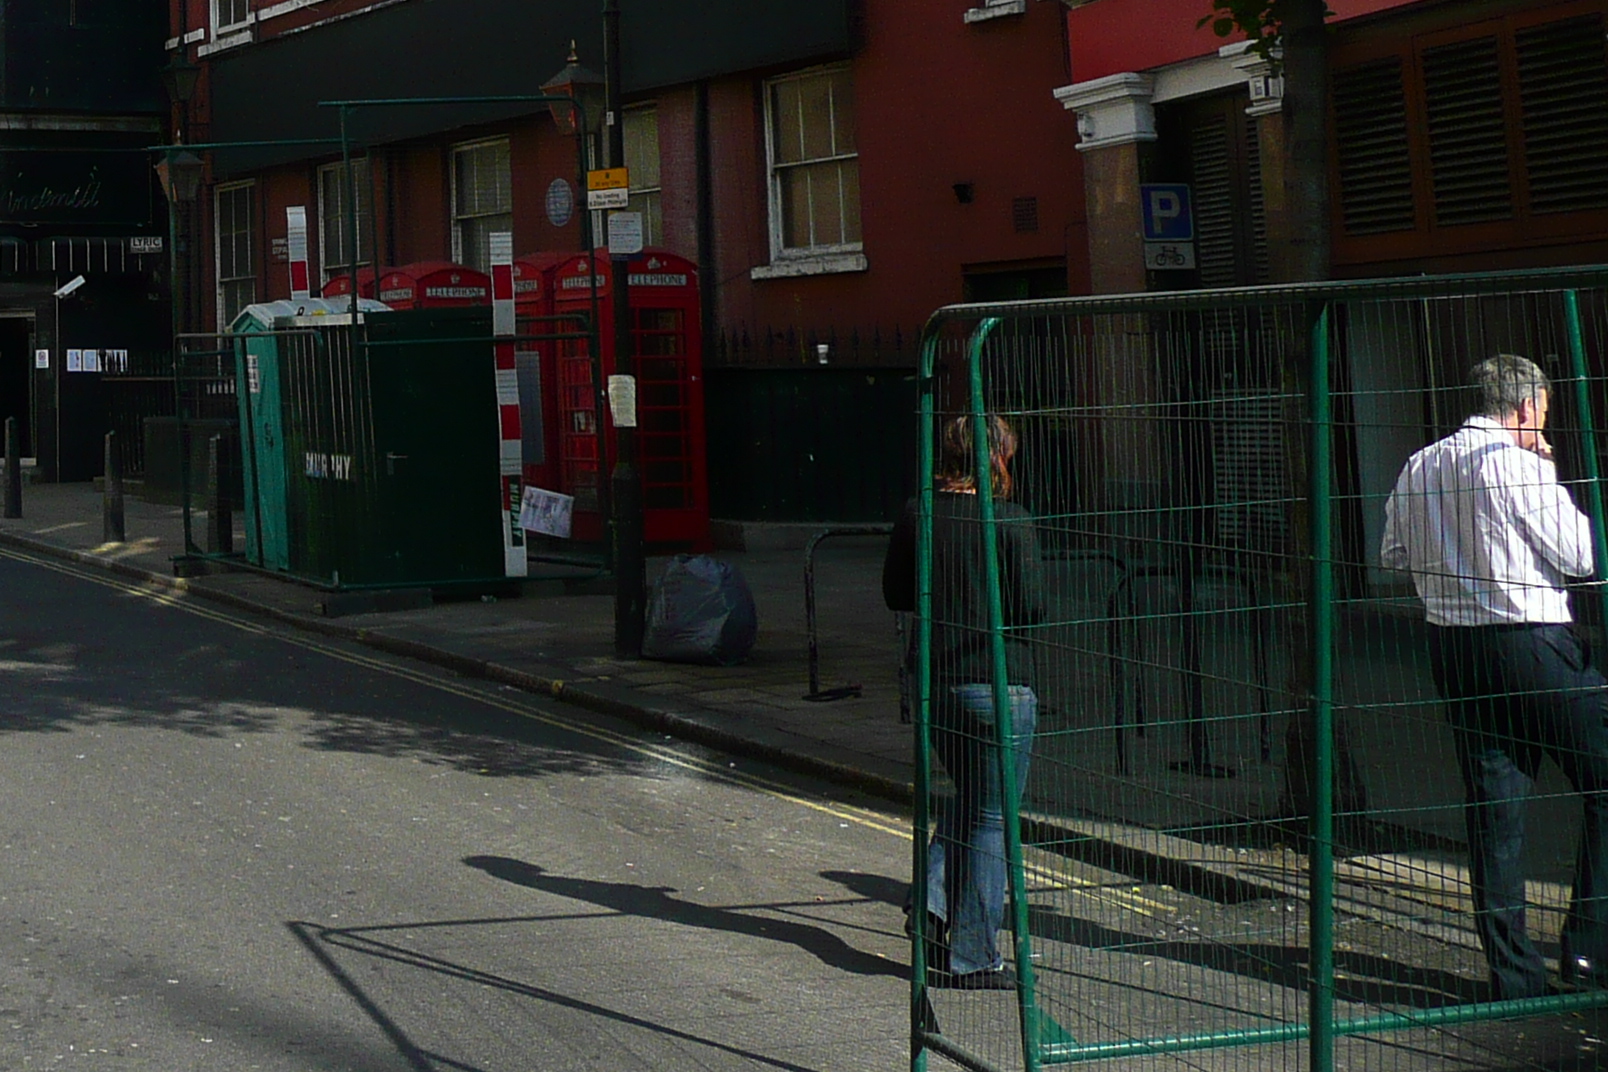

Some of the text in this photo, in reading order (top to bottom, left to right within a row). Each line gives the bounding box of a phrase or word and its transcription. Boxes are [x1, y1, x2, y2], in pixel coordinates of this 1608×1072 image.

[1150, 190, 1181, 234] P
[132, 236, 161, 247] LYRIC
[630, 274, 685, 286] ELEPHONE
[428, 287, 483, 298] TELEPHONE
